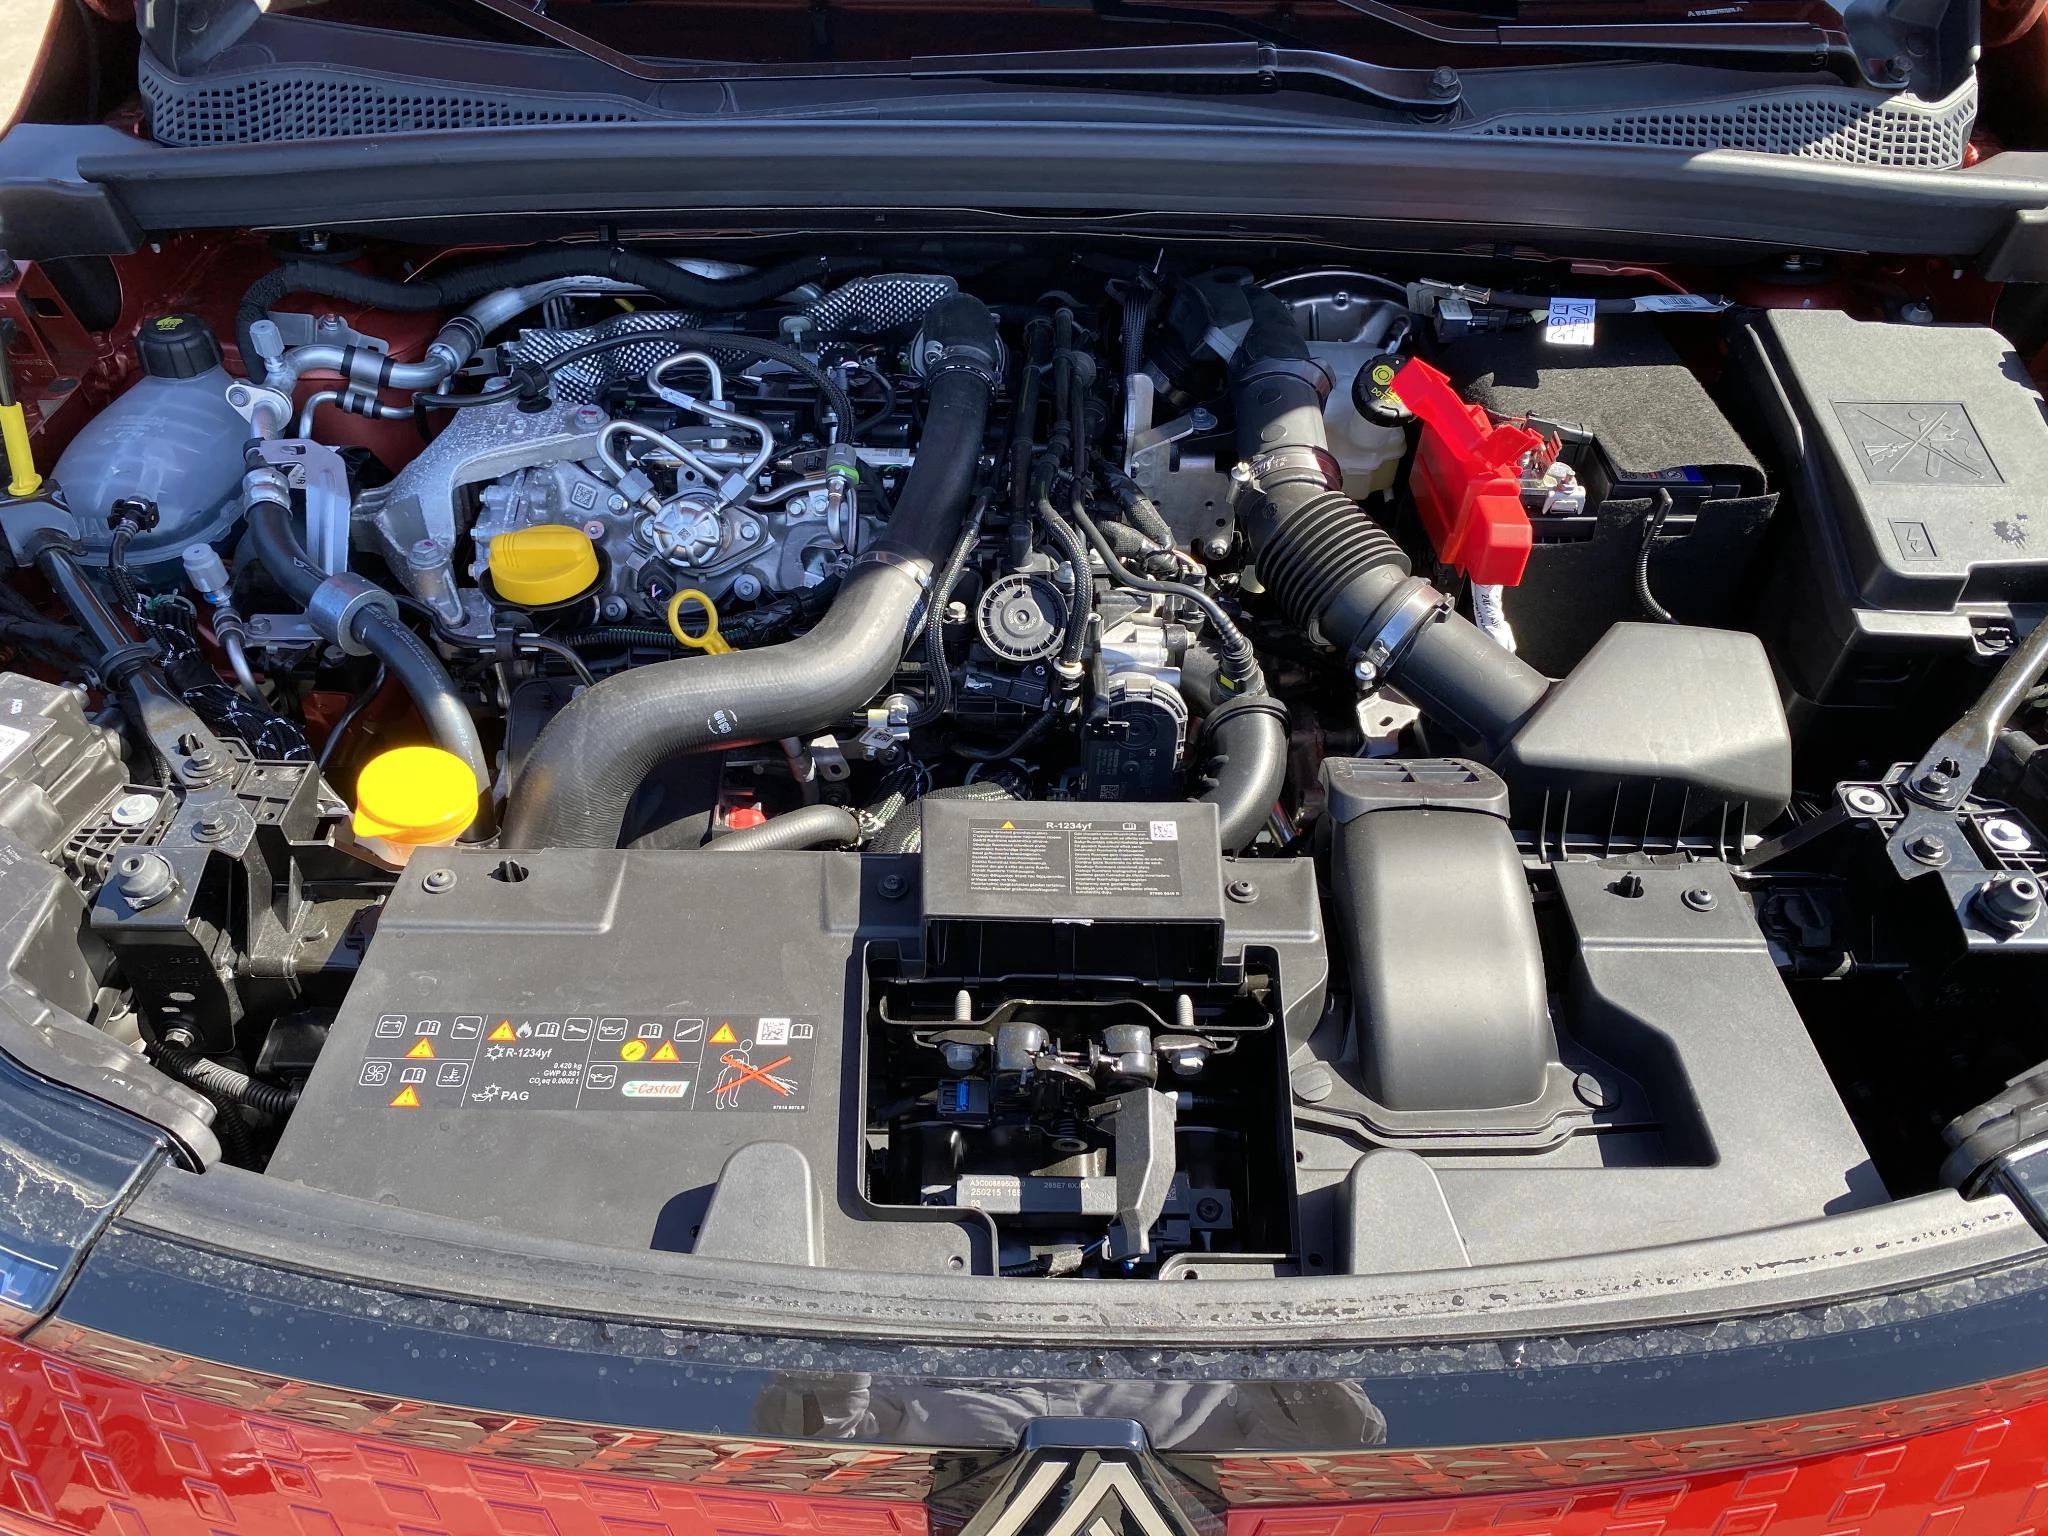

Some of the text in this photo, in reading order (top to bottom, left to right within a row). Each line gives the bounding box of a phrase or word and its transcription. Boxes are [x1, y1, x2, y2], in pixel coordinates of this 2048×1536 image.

[1371, 387, 1386, 400] DOT
[1046, 820, 1092, 831] R-1234yf
[505, 1048, 552, 1060] R-1234yf
[638, 1083, 682, 1094] Castrol
[500, 1090, 530, 1101] PAG
[970, 1188, 1001, 1196] 250215
